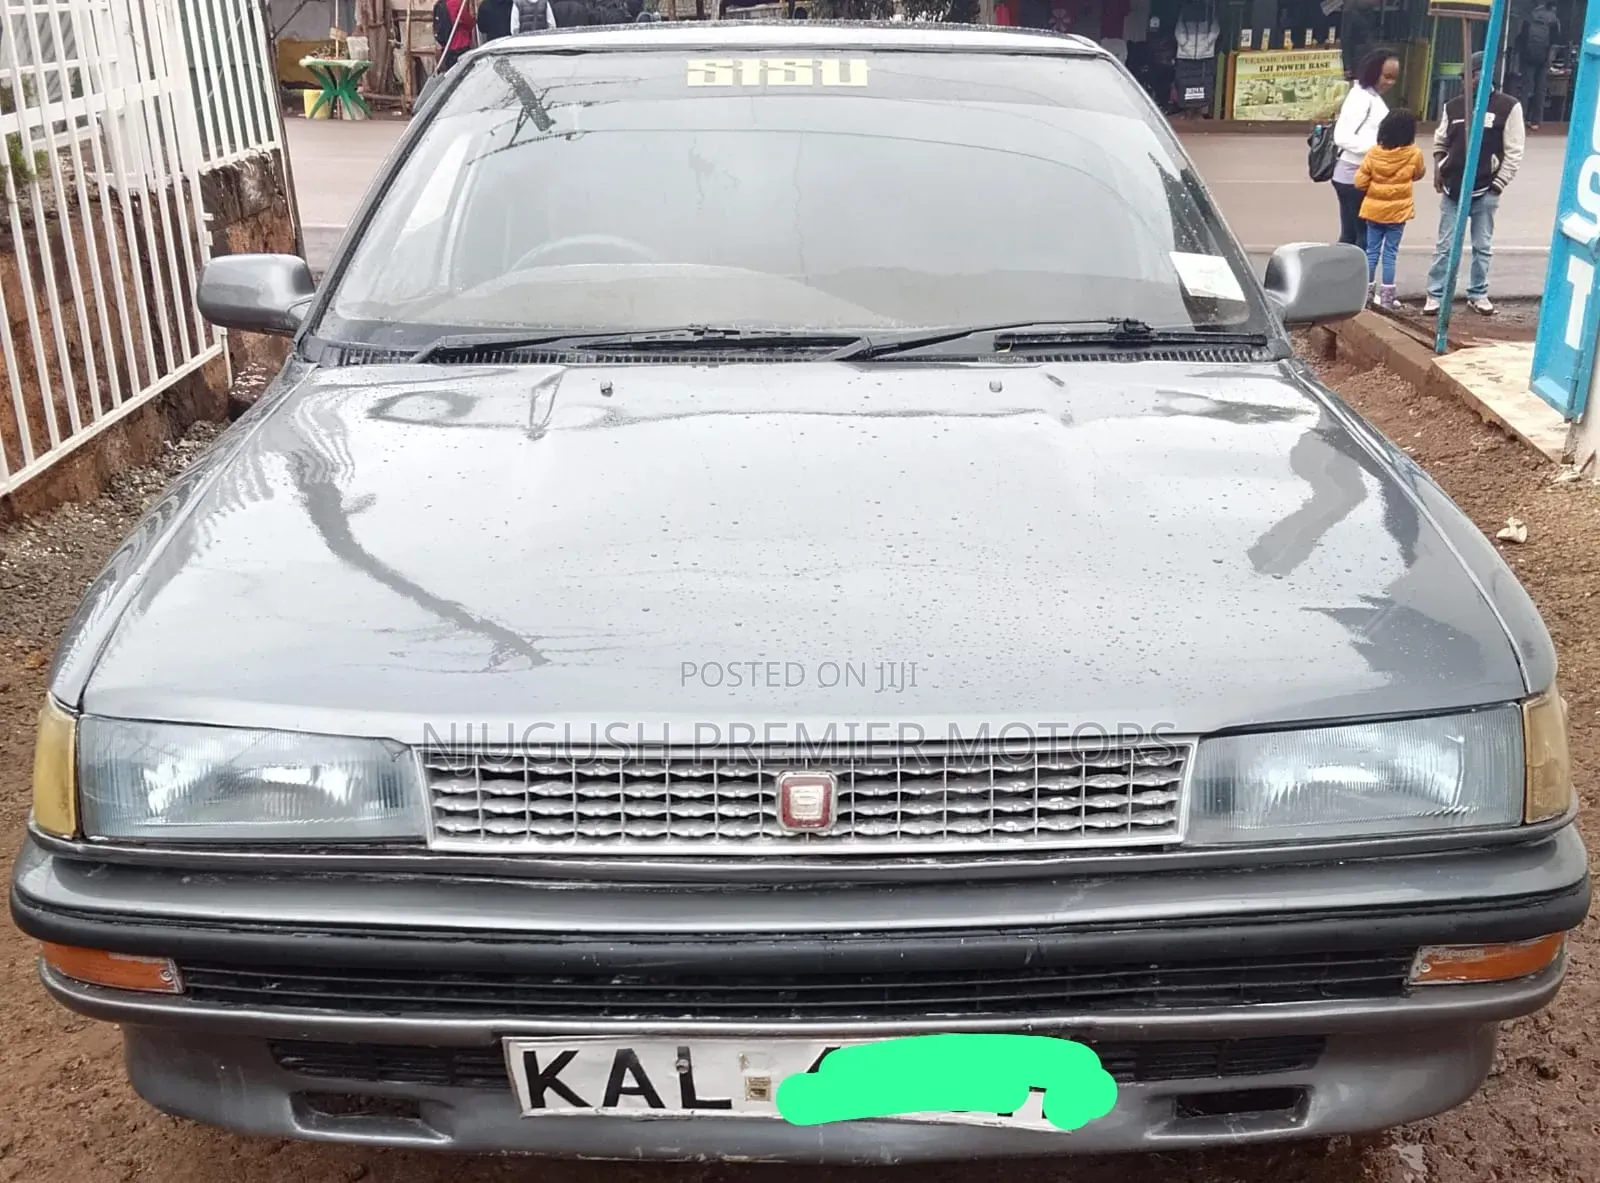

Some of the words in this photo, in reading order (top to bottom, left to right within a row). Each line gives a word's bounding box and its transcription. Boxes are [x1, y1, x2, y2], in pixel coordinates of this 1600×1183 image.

[687, 58, 869, 87] SISU
[1276, 63, 1306, 71] POWER
[1308, 61, 1331, 69] BASE
[523, 1046, 732, 1109] KAL
